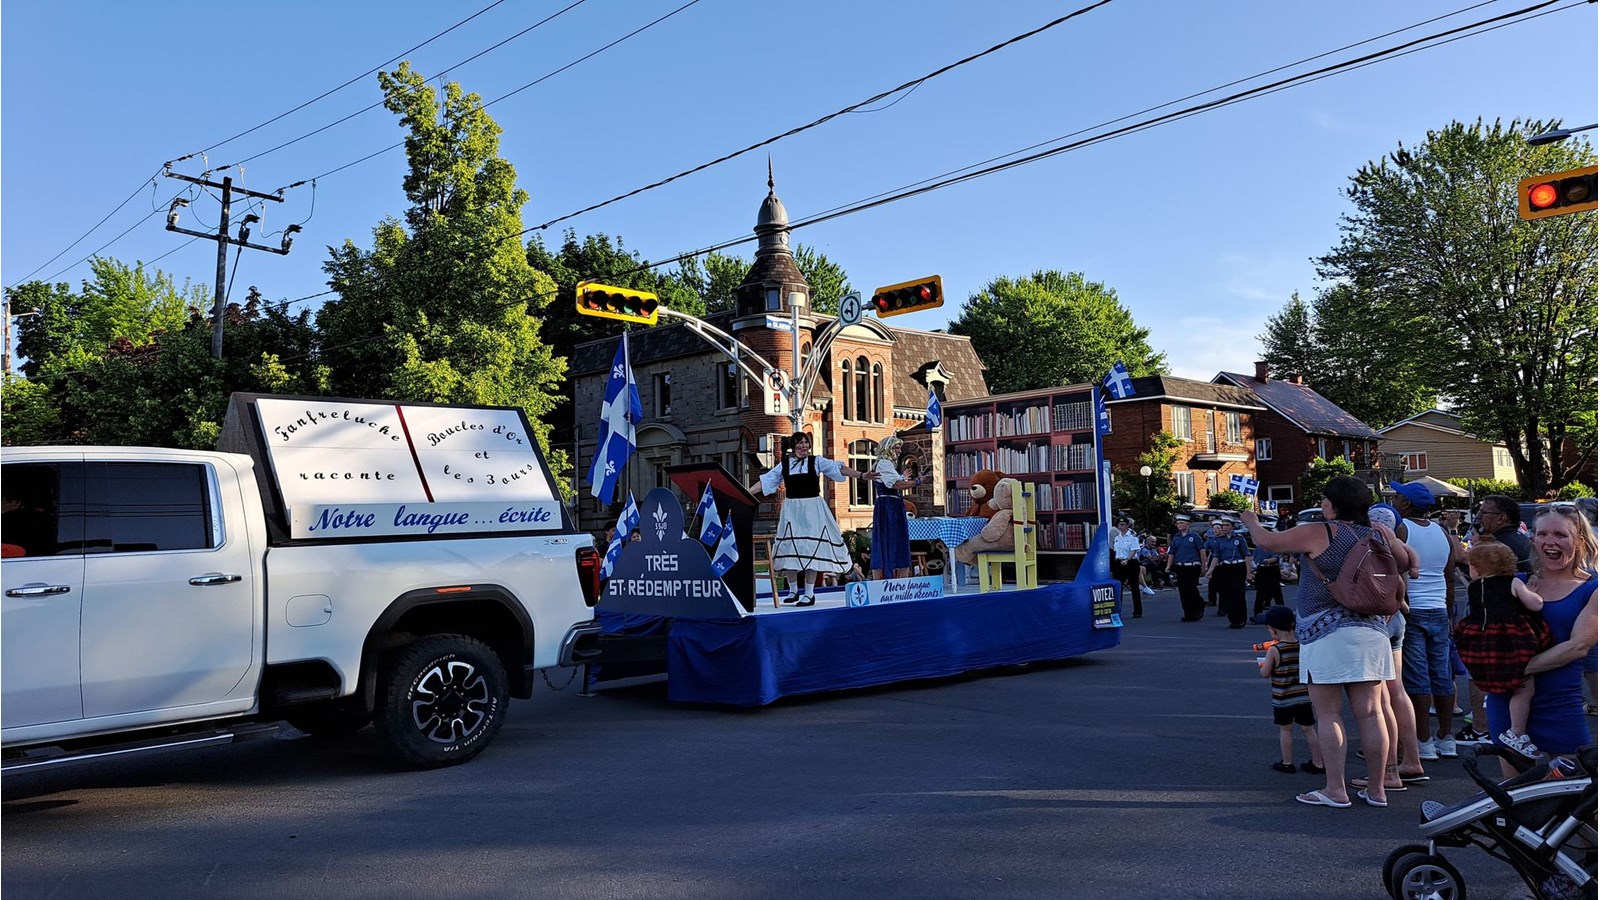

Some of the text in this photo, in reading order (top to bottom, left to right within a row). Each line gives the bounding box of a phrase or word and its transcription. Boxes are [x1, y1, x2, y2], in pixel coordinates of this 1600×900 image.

[274, 410, 400, 441] Fanfreluche
[427, 421, 523, 447] Boucles d'Or
[474, 451, 490, 459] et
[299, 471, 395, 480] raconte
[443, 463, 533, 485] les 3 ours
[308, 507, 376, 532] Notre
[393, 504, 469, 534] langue
[498, 506, 551, 524] écrite
[654, 522, 668, 530] SSJB
[645, 550, 679, 572] TRÈS
[882, 579, 930, 592] Notre langue
[880, 594, 893, 602] aux
[894, 590, 913, 601] mille
[1092, 586, 1115, 602] VOTEZ!
[443, 744, 460, 752] T/A
